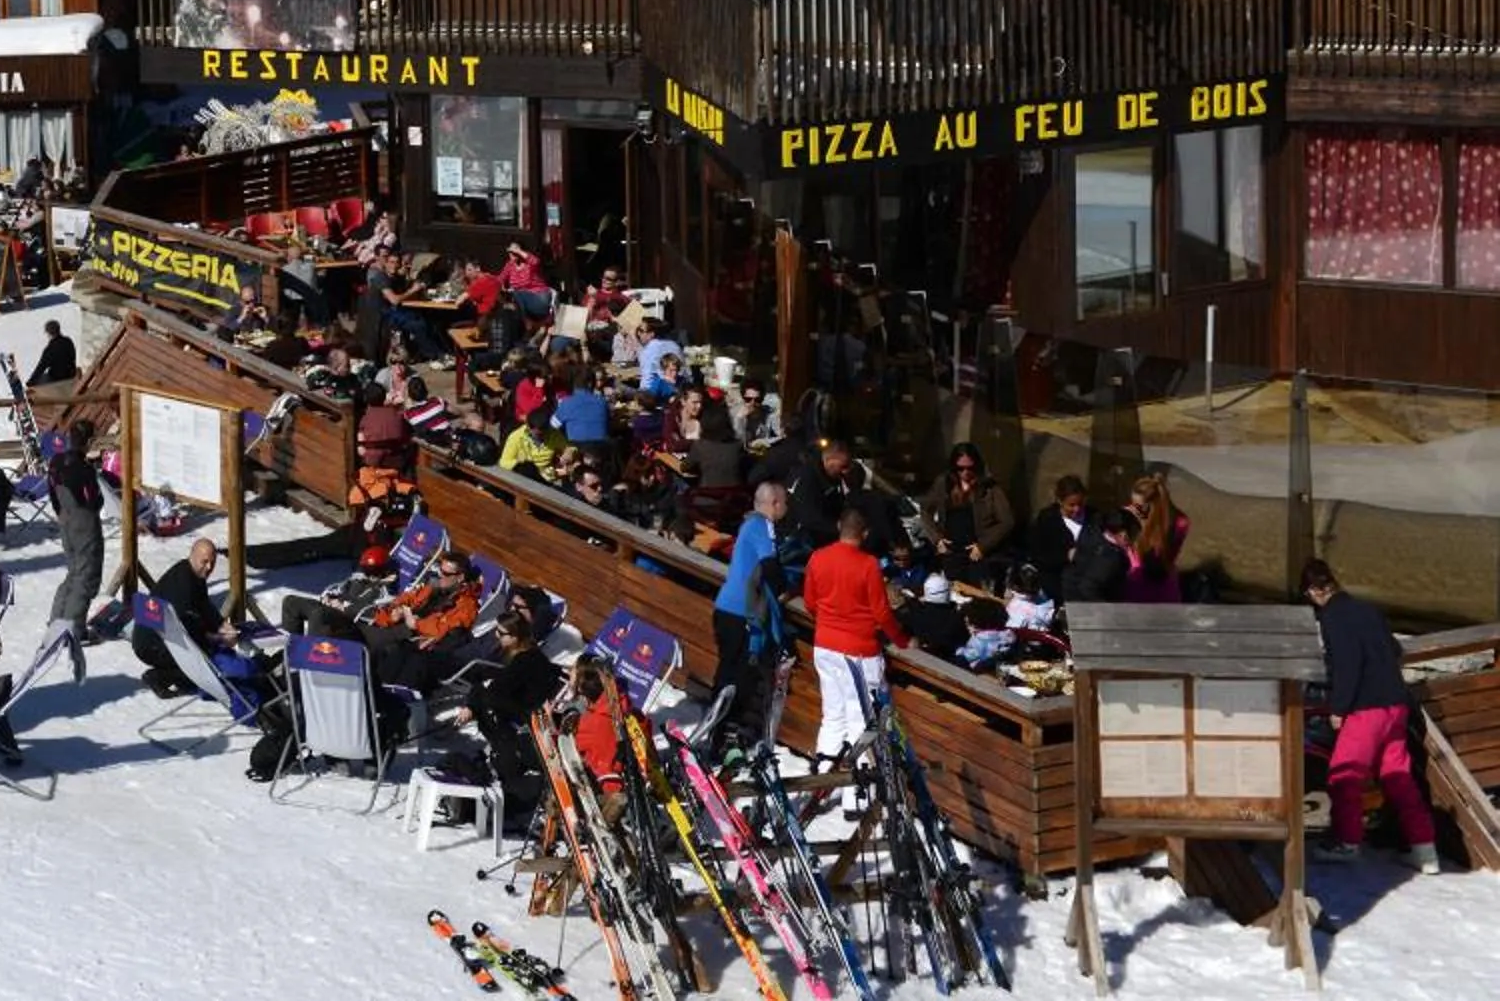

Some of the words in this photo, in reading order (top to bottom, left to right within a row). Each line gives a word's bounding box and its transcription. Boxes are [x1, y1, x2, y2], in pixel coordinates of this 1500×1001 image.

[203, 50, 481, 86] RESTAURANT
[781, 120, 899, 168] PIZZA
[934, 111, 977, 151] AU
[1015, 100, 1083, 142] FEU
[1117, 92, 1158, 130] DE
[1191, 79, 1268, 122] BOIS
[111, 230, 241, 295] PIZZERIA
